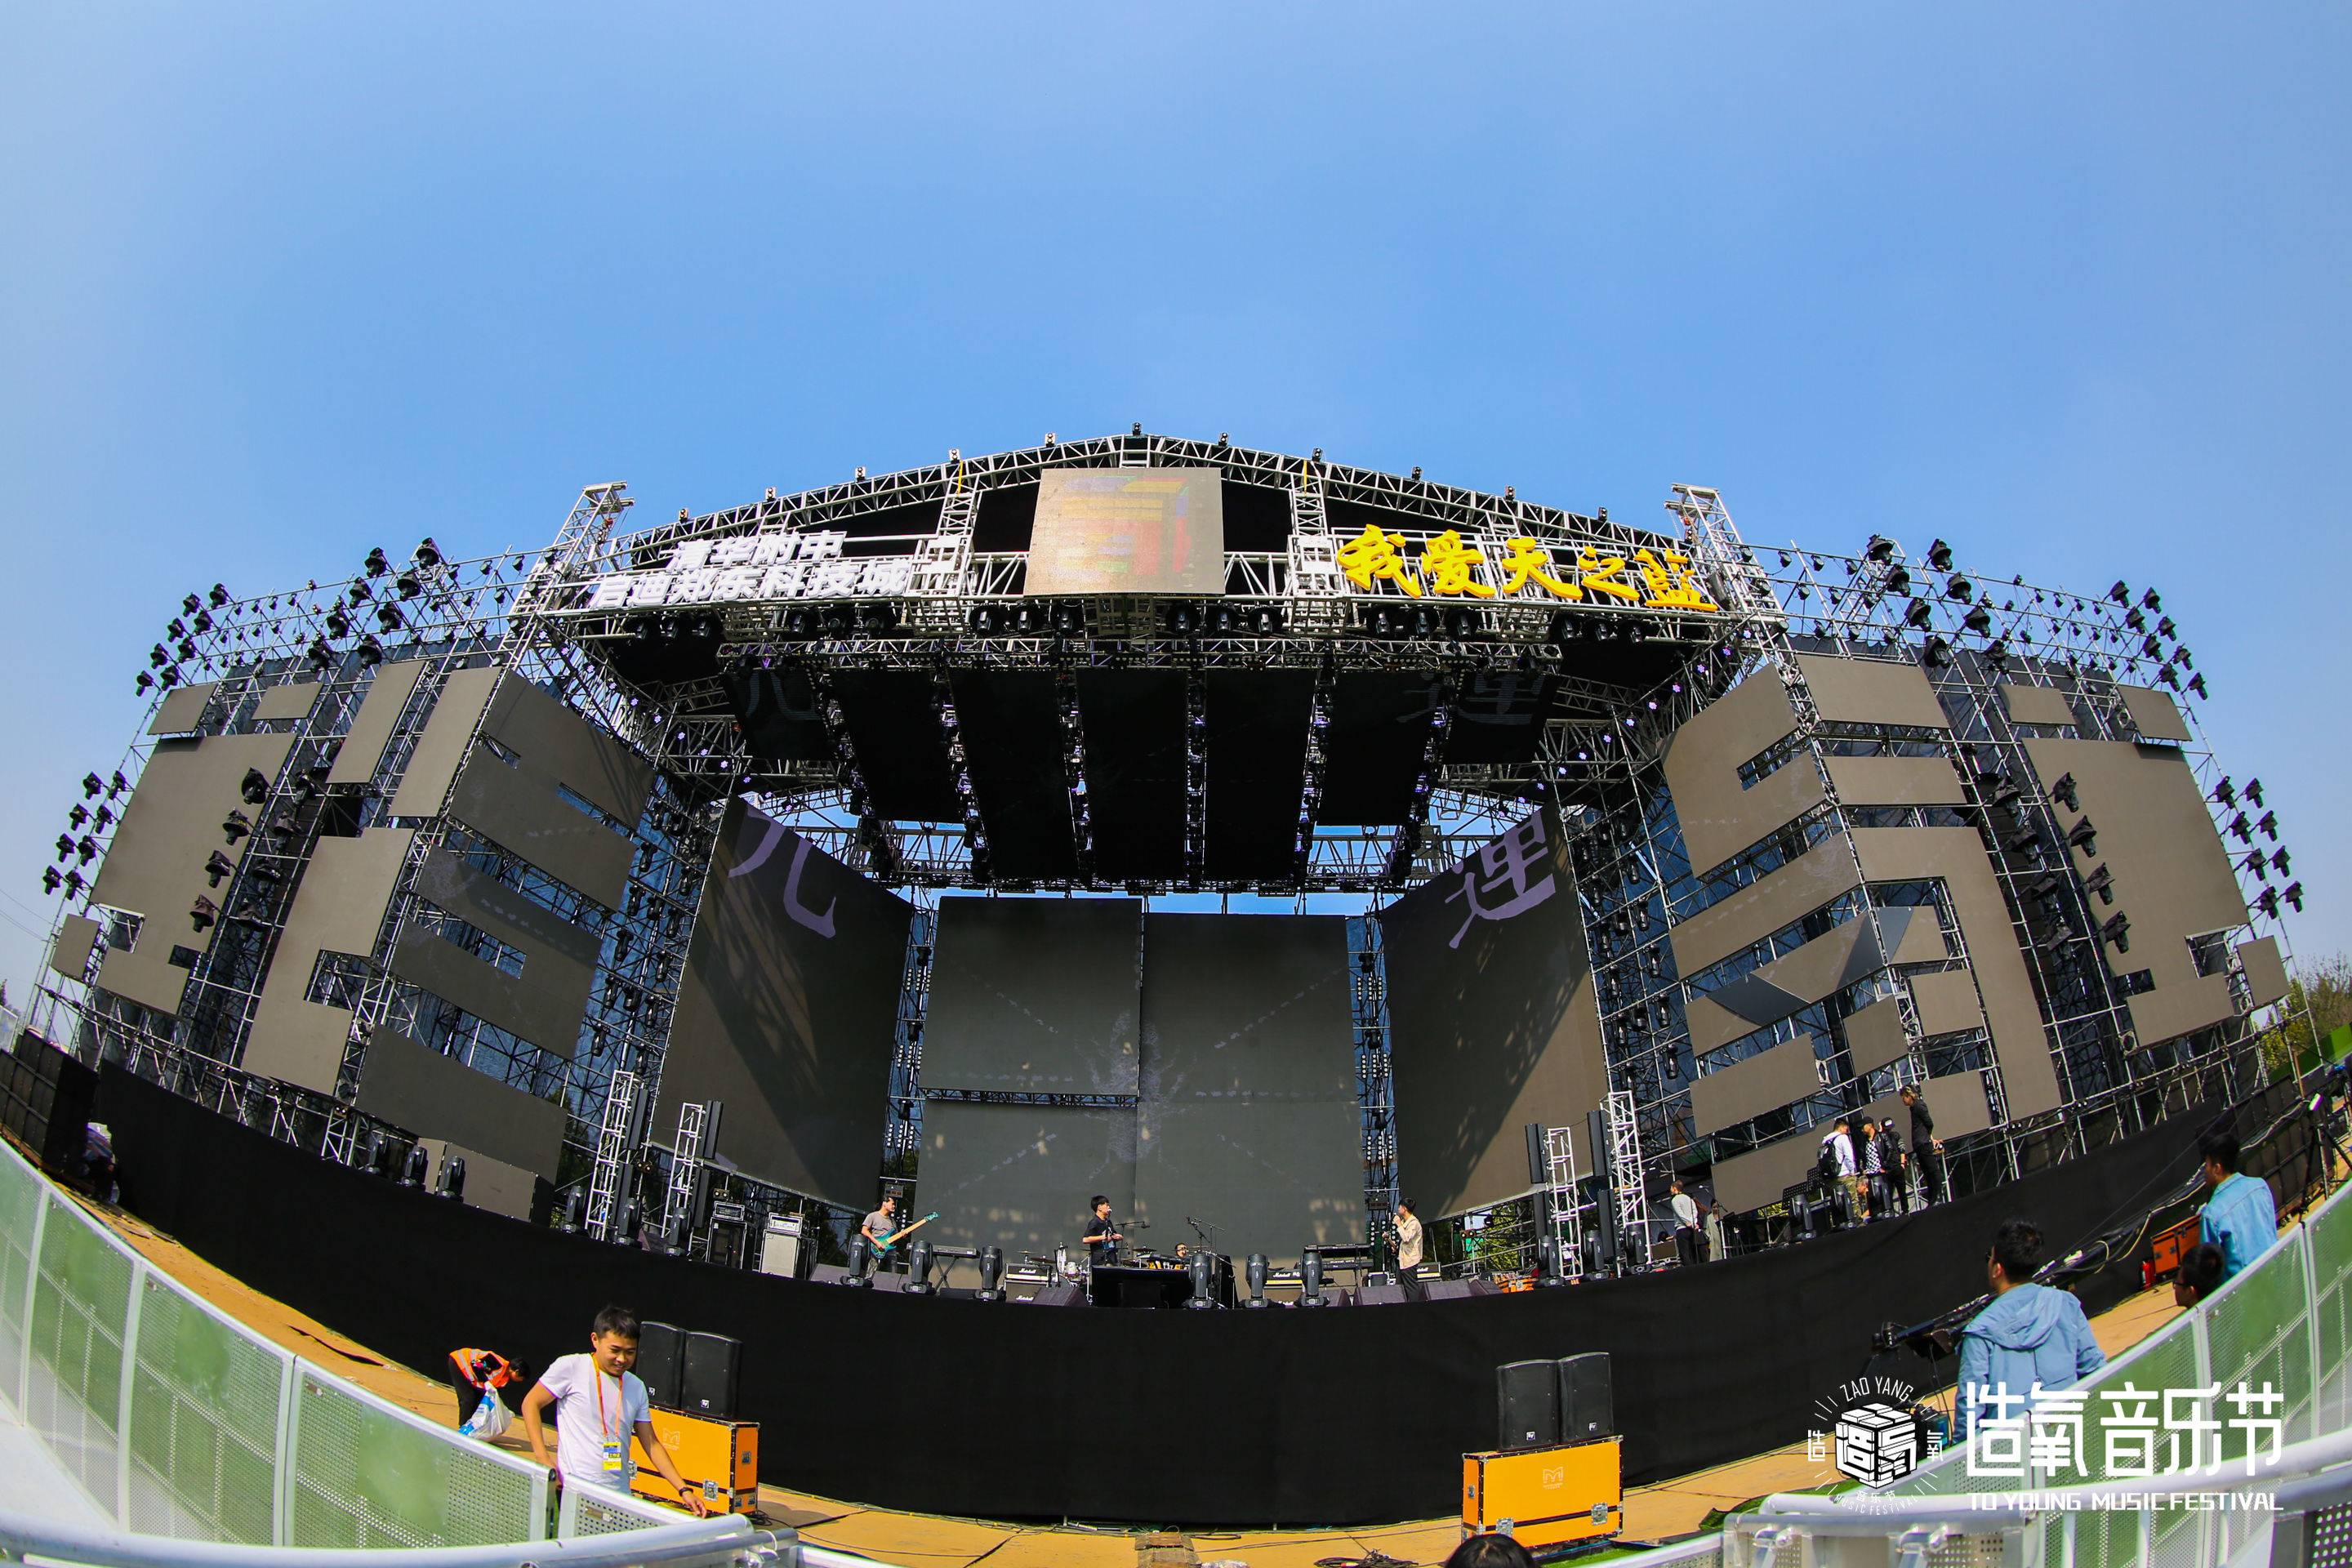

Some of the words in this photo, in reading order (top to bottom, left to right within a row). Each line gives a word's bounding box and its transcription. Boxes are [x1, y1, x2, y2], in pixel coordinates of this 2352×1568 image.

[666, 530, 844, 572] 清华附中
[589, 559, 911, 609] 启迪郑东科技城
